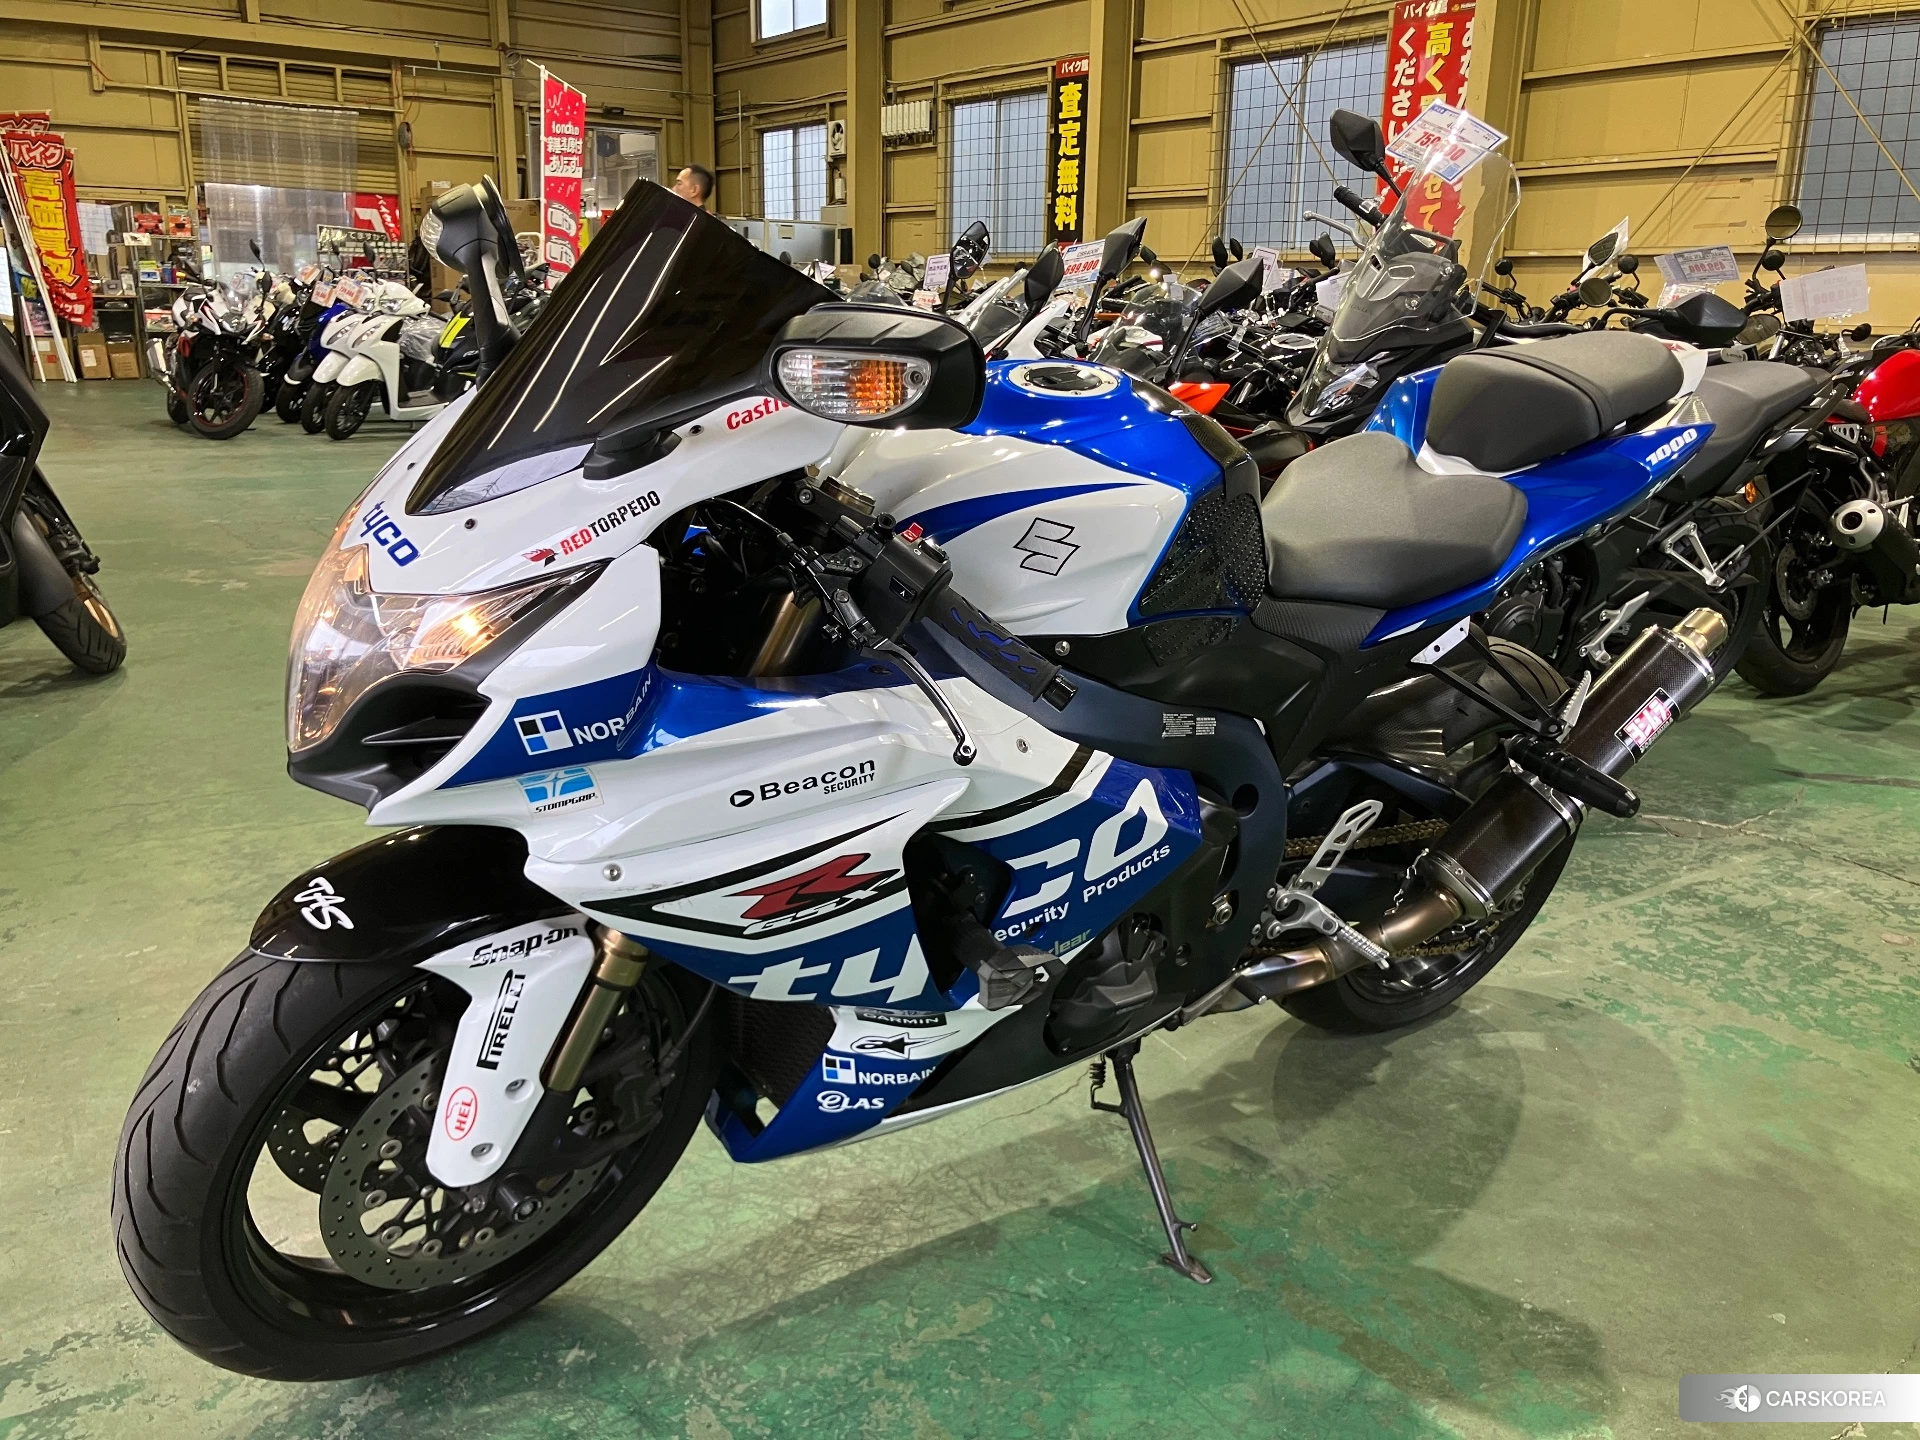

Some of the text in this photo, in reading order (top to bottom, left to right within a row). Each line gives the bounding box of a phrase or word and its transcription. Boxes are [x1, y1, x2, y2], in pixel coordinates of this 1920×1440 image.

[12, 142, 62, 166] バイク
[1054, 81, 1083, 231] 査定無料
[18, 170, 77, 286] 高価買取
[1645, 428, 1698, 466] 1000
[573, 673, 652, 745] NORBAIN
[759, 759, 875, 801] Beacon
[824, 773, 876, 795] SECURITY
[534, 792, 597, 813] STOMPGRIP
[1083, 844, 1171, 903] Products
[469, 928, 579, 968] Snap-on
[476, 969, 527, 1070] PIRELLI
[862, 1012, 939, 1024] GARMIN
[455, 1098, 474, 1132] HEL
